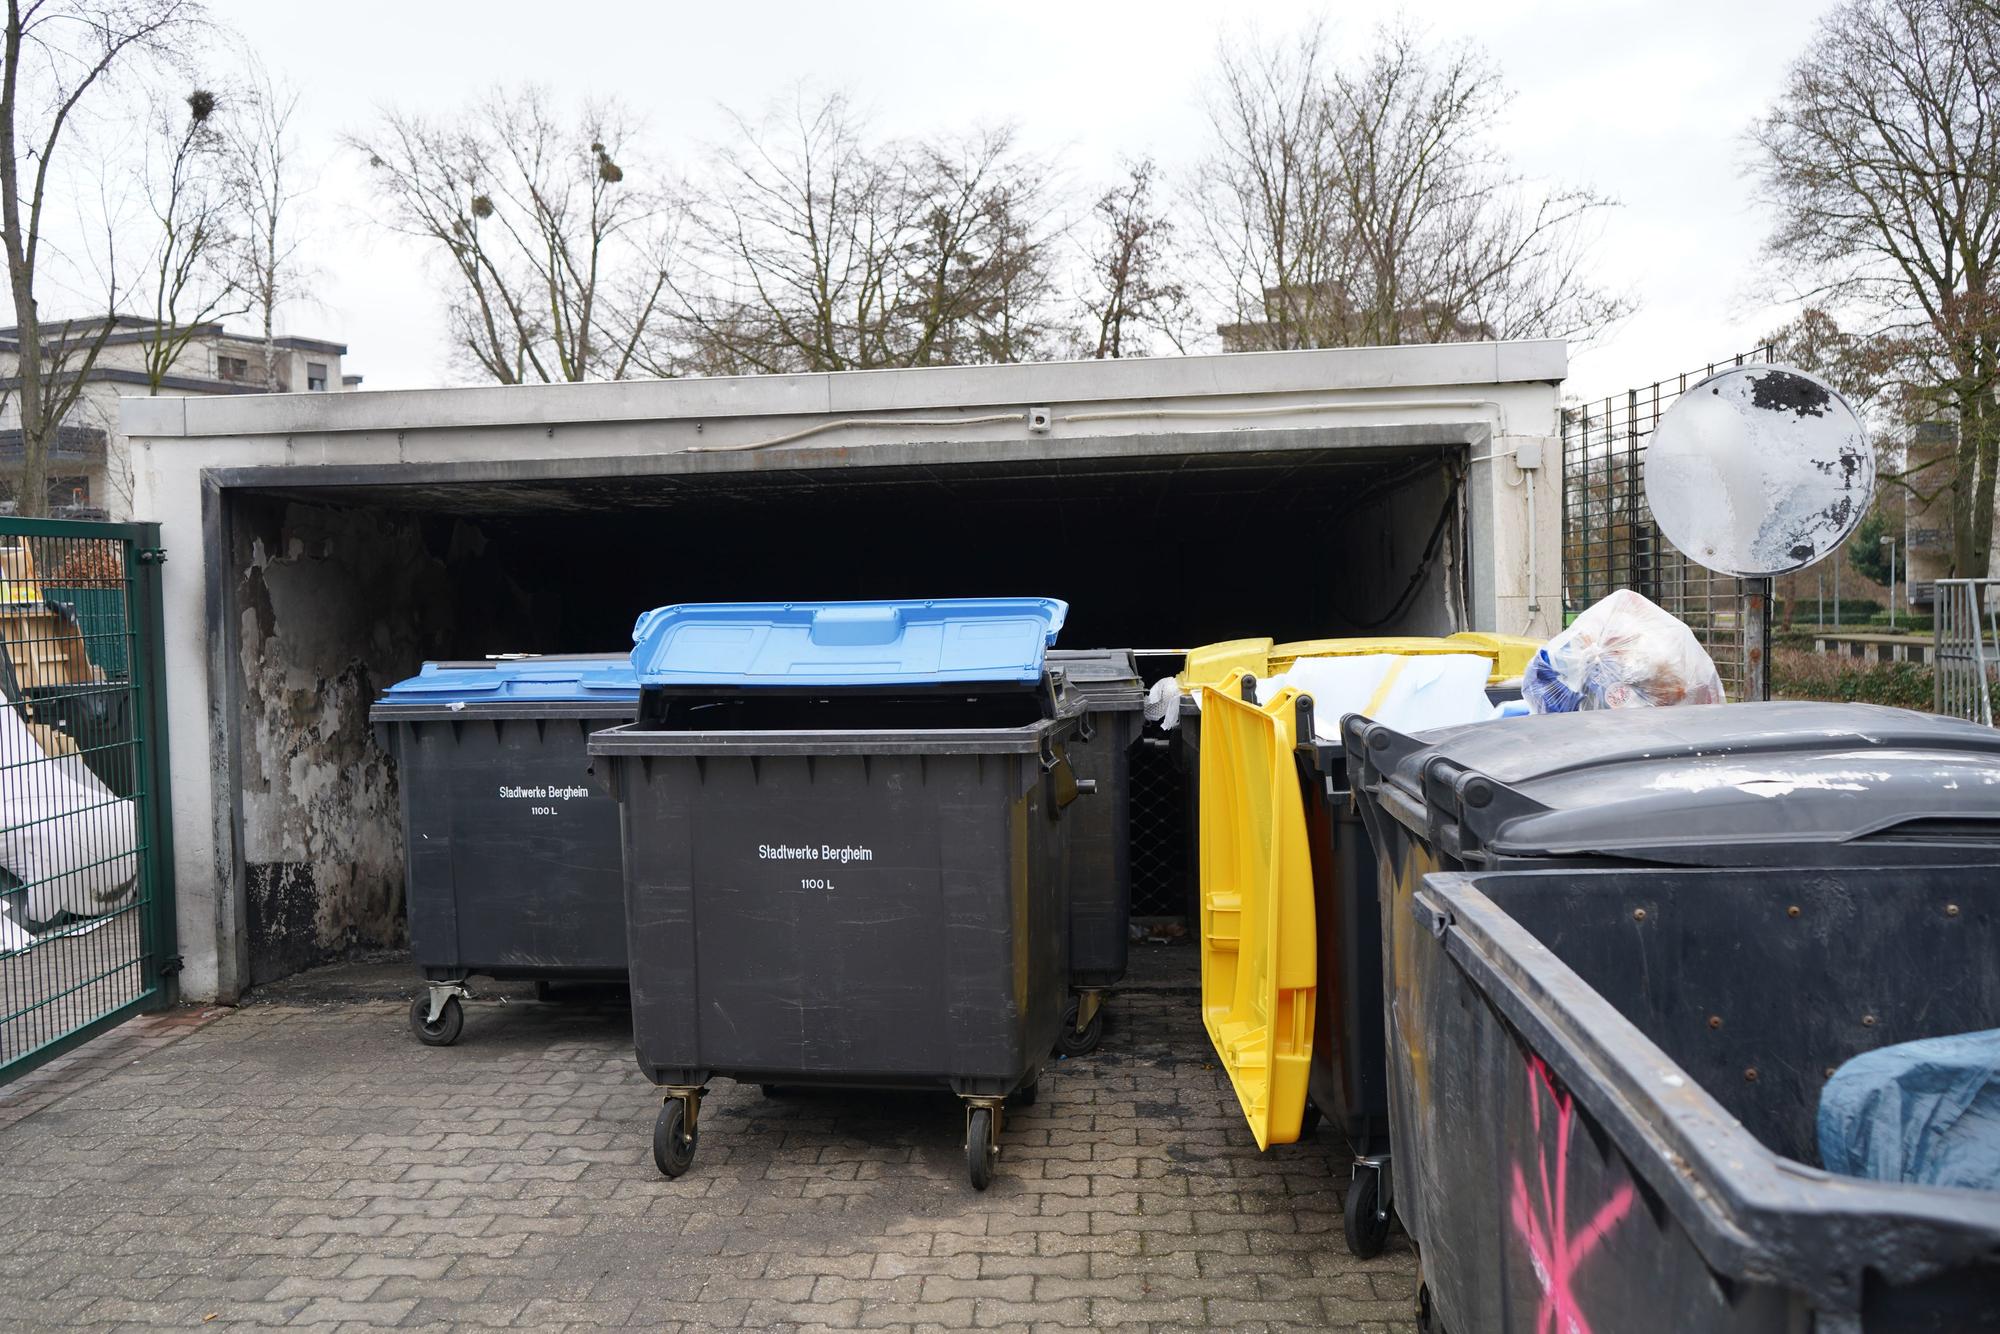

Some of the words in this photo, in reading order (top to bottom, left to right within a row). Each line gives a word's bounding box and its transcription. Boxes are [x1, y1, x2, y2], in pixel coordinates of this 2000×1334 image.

[499, 785, 547, 798] Stadtwerke
[548, 785, 589, 801] Bergheim
[531, 806, 550, 815] 1100
[551, 806, 558, 815] L
[758, 844, 819, 860] Stadtwerke
[821, 844, 873, 864] Bergheim
[801, 879, 824, 889] 1100
[826, 879, 835, 890] L
